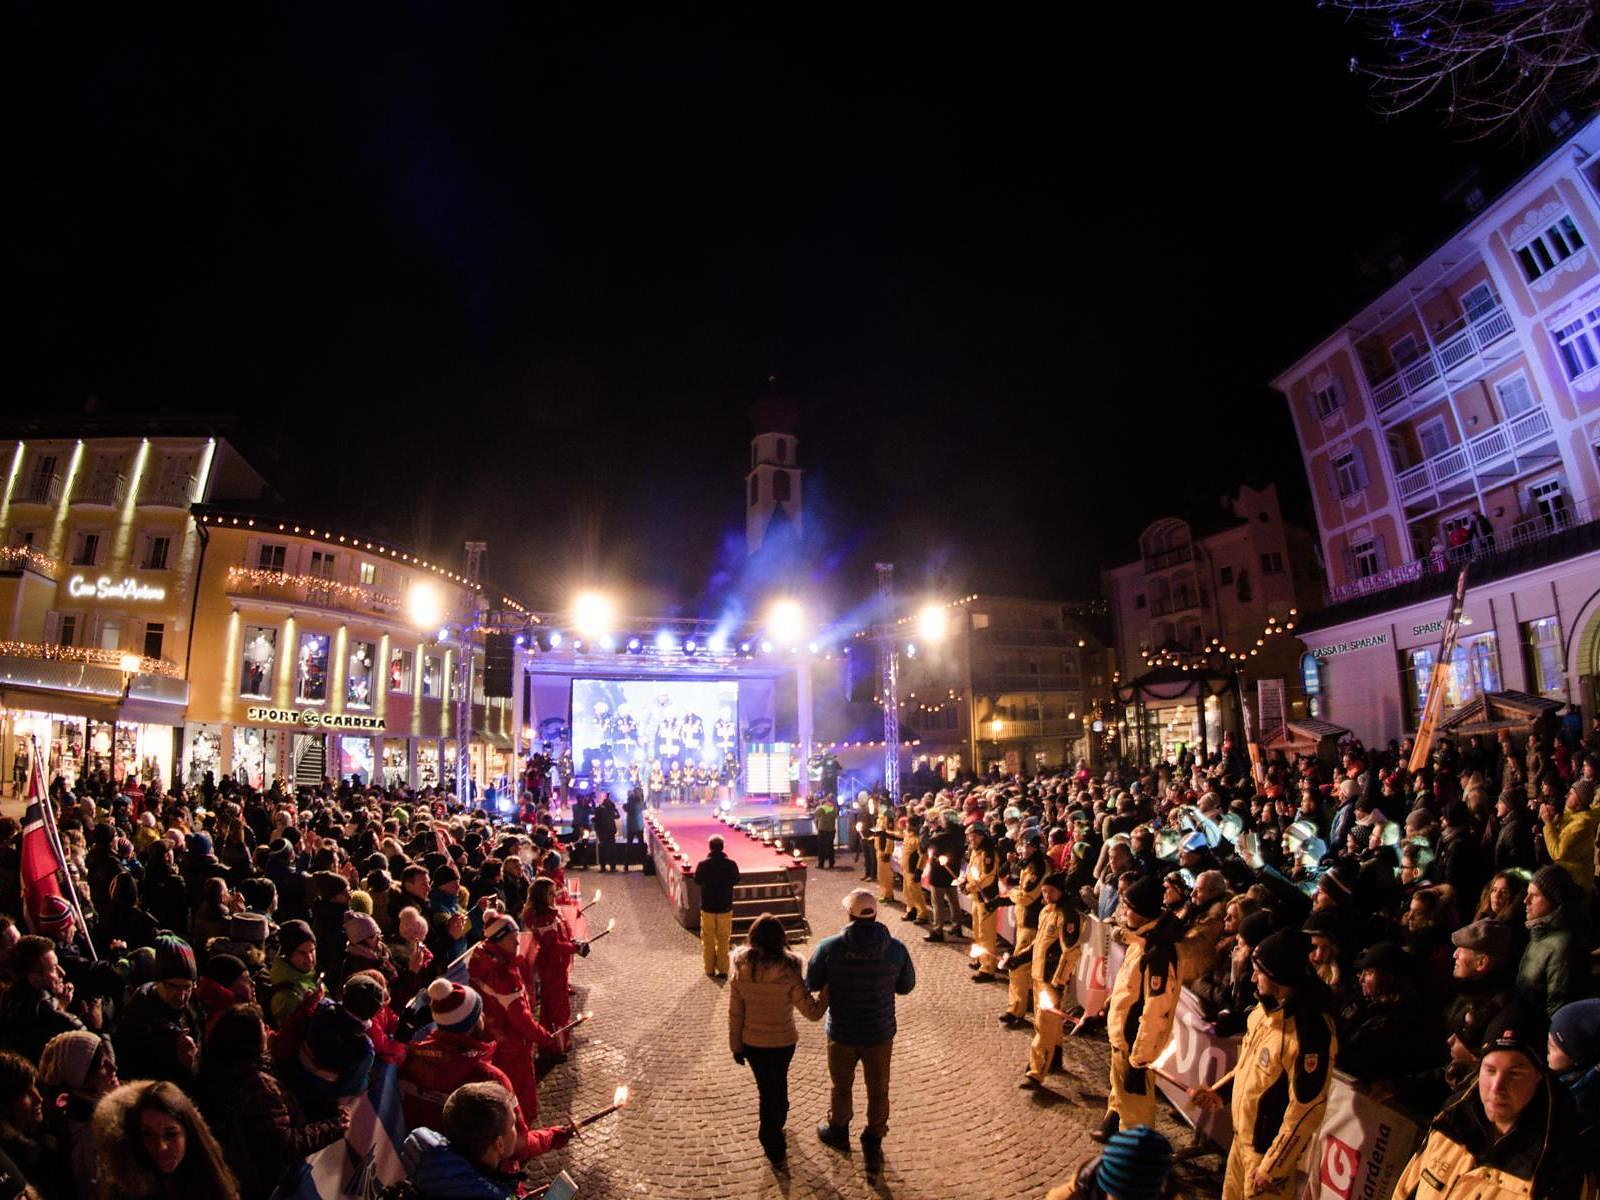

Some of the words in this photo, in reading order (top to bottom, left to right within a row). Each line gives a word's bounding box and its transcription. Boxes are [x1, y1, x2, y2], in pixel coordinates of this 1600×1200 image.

[1312, 645, 1338, 658] CASSA
[248, 707, 299, 722] SPORT
[323, 715, 386, 729] GARDENA
